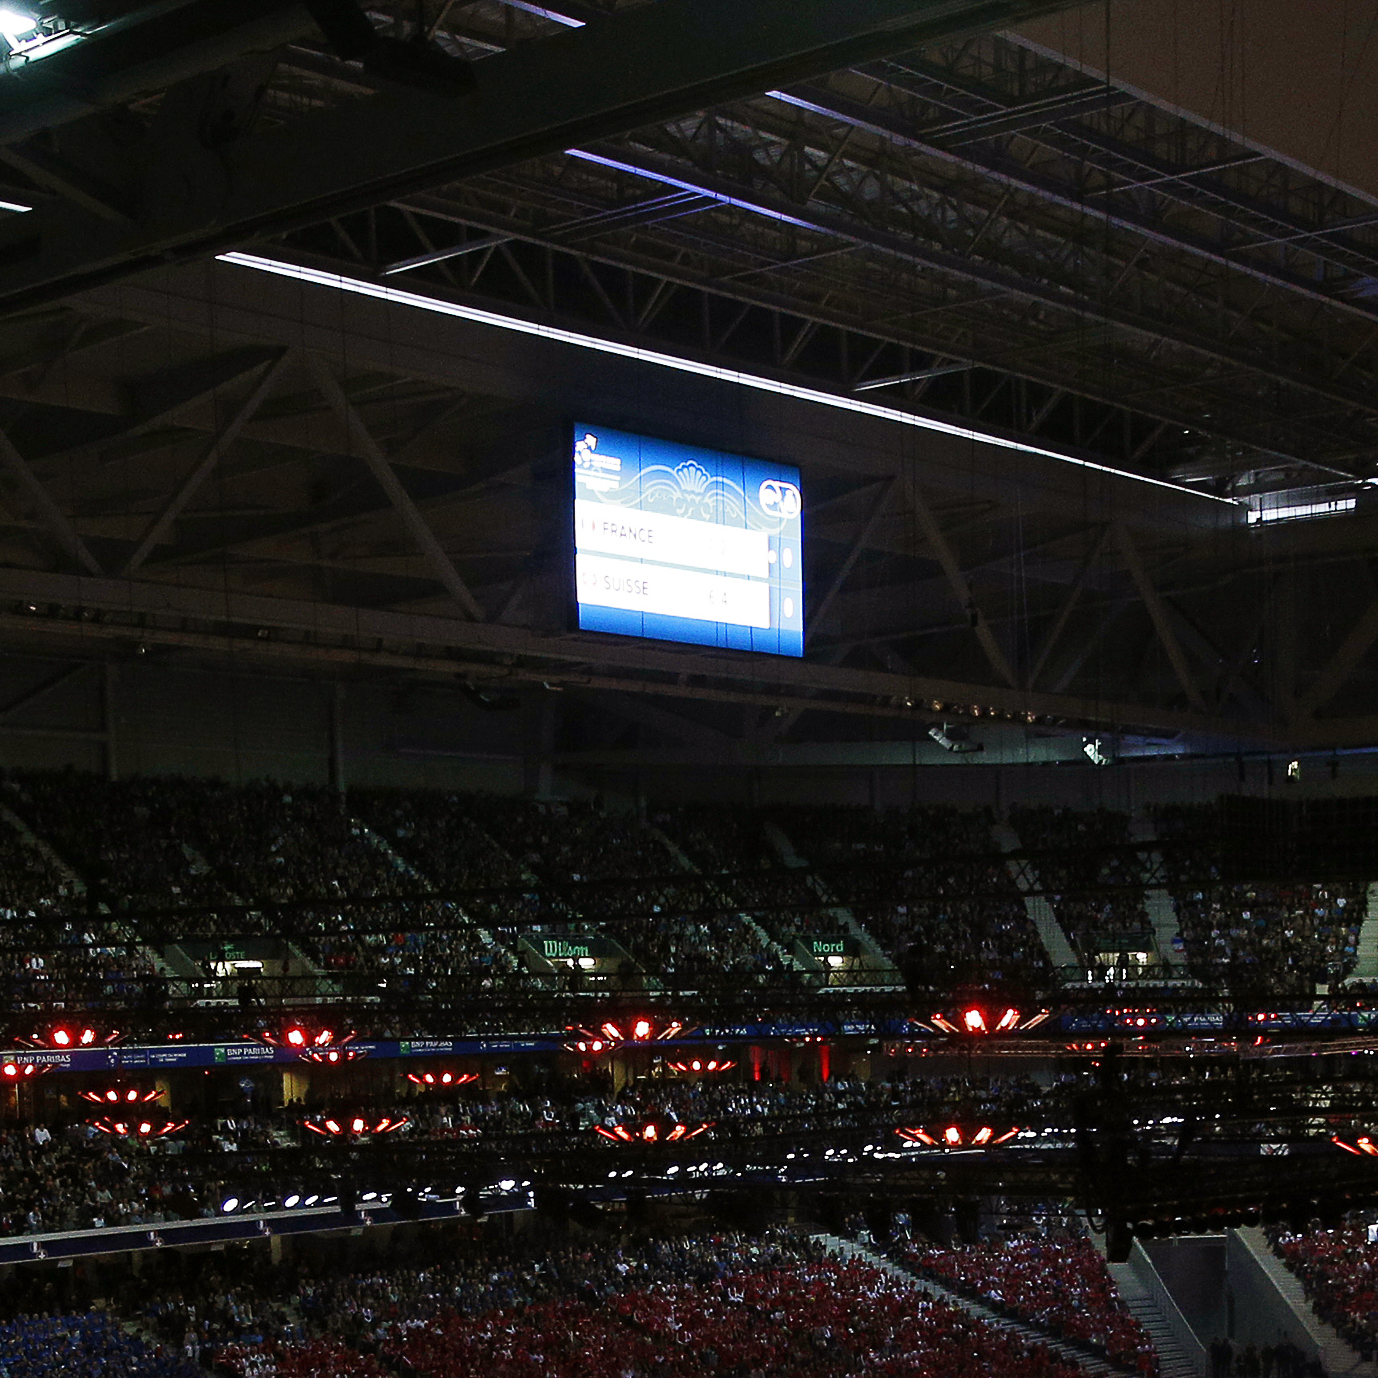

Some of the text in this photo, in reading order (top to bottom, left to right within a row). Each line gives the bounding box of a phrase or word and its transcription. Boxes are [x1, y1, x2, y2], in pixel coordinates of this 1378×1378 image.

[603, 522, 654, 544] FRANCE
[604, 575, 649, 595] SUISSE
[543, 940, 590, 957] Wilson
[812, 940, 845, 953] Nord
[209, 951, 245, 960] LOSTE
